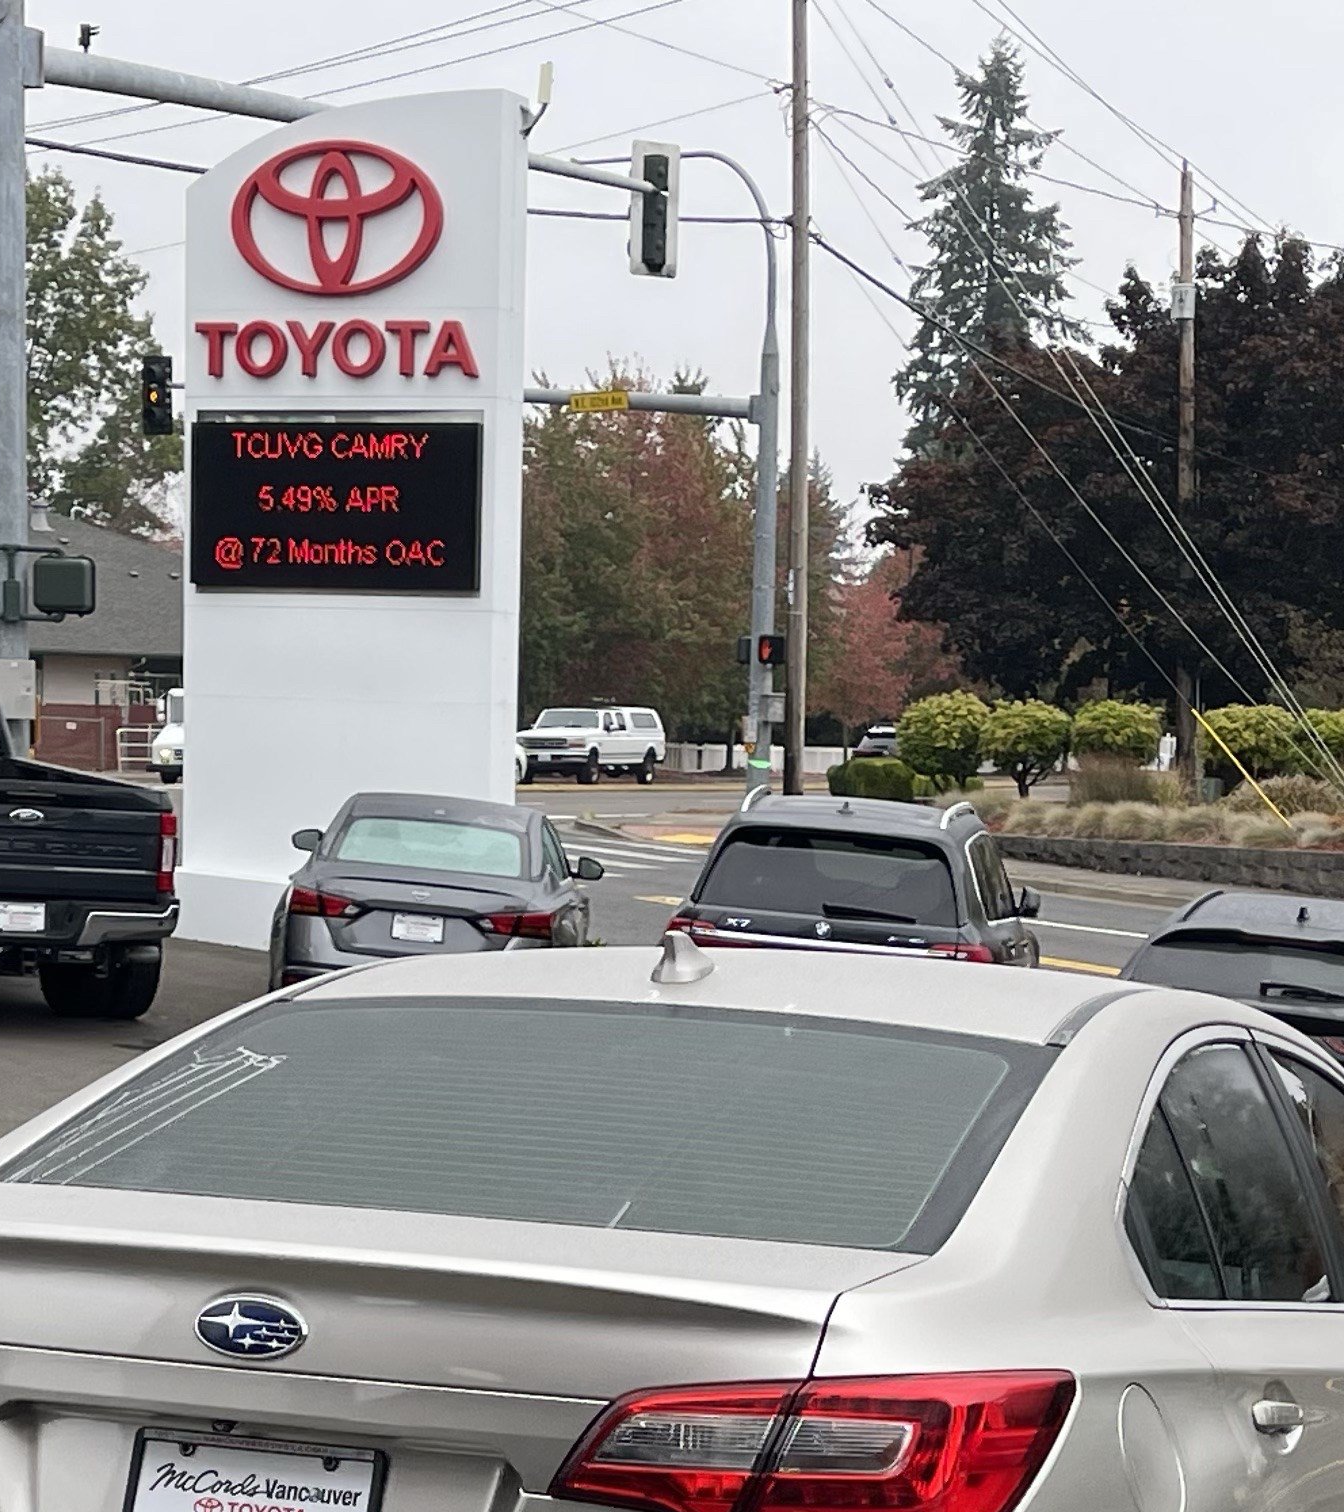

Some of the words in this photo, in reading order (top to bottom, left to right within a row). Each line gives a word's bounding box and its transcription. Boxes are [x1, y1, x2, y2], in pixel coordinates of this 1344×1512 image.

[195, 320, 479, 379] TOYOTA
[331, 432, 429, 460] CAMRY
[258, 485, 339, 513] 5.49%
[346, 485, 400, 513] APR
[214, 537, 244, 569] @
[251, 537, 282, 565] 72
[288, 537, 378, 565] Months
[385, 539, 446, 567] OAC
[264, 1478, 363, 1508] Vancouver
